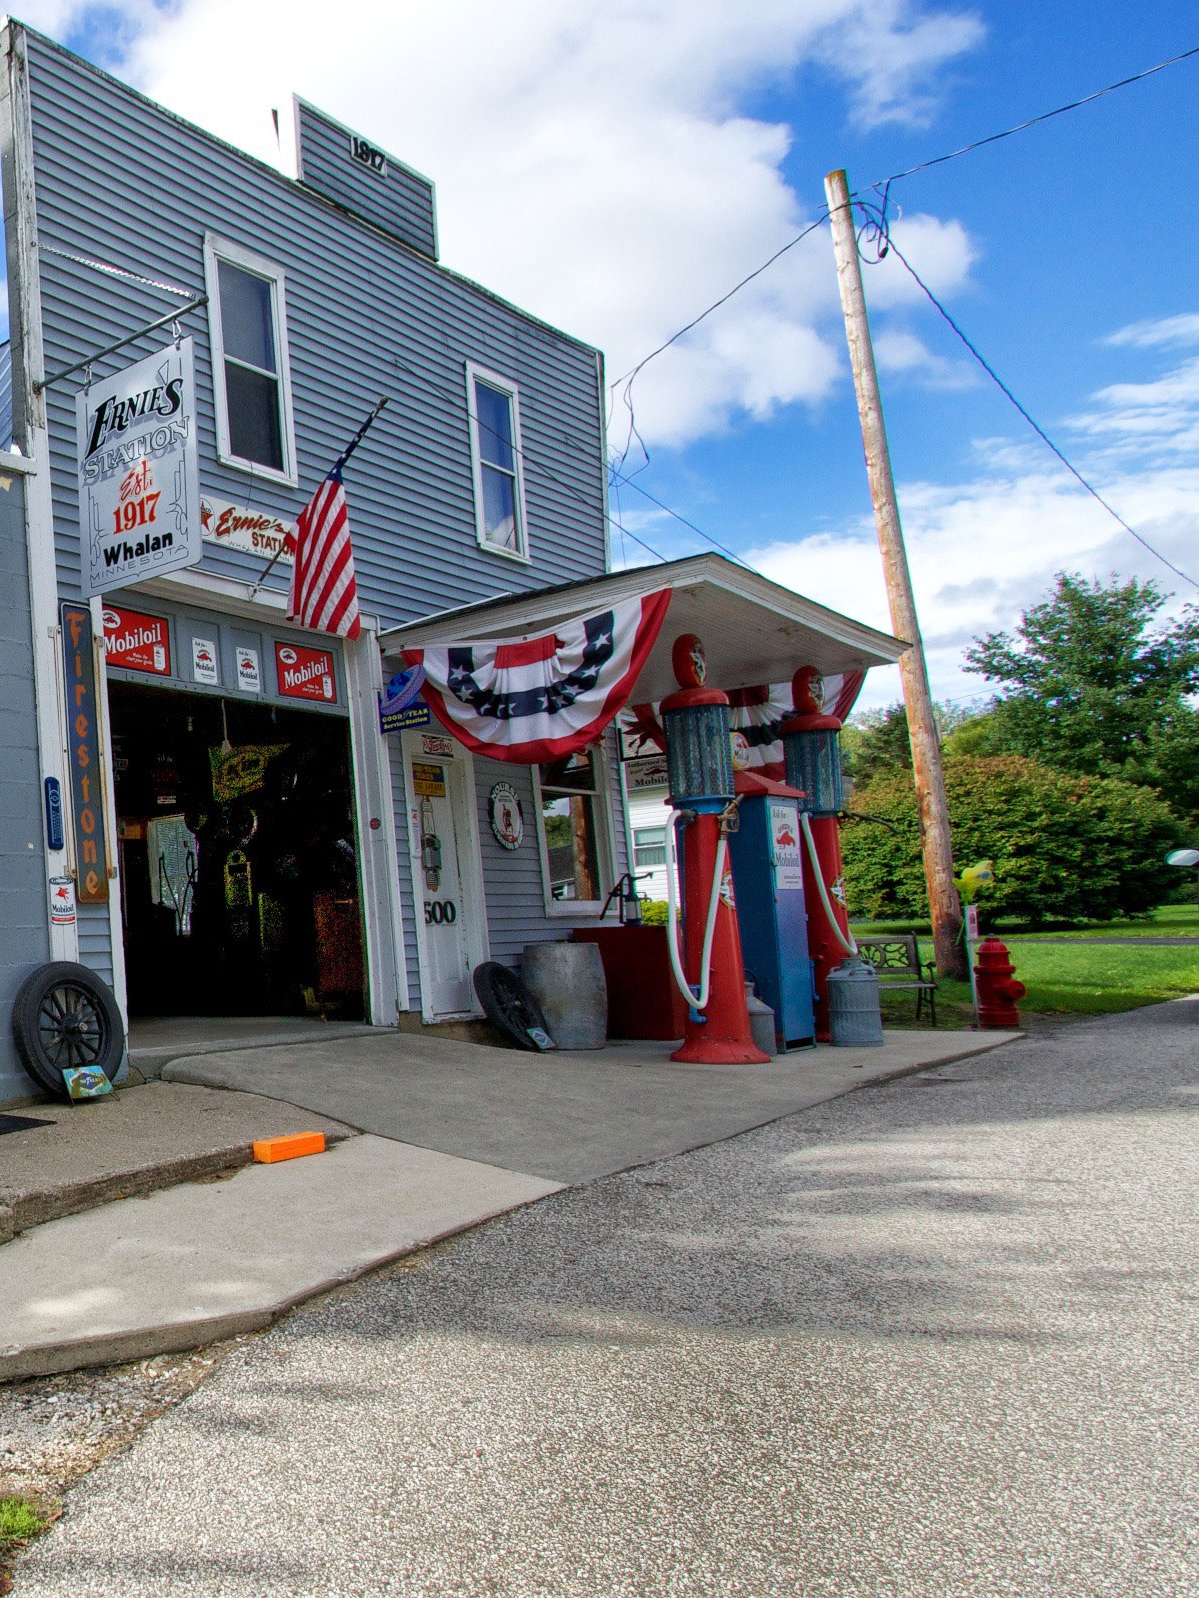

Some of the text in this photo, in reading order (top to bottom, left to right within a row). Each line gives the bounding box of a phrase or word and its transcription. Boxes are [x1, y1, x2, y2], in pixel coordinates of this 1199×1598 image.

[84, 416, 190, 482] STATION
[113, 491, 161, 535] 1917
[216, 507, 287, 537] Ernie's
[104, 532, 173, 567] Whalan
[251, 531, 296, 557] STATIO
[90, 544, 187, 582] MINNESOTA
[103, 623, 162, 656] Mobiloil
[195, 661, 215, 673] Mobiloil
[283, 656, 329, 689] Mobiloil
[383, 717, 428, 730] Service Station
[66, 612, 100, 894] Firestone
[626, 758, 660, 769] Authorized
[775, 852, 799, 867] Mobiloil
[52, 903, 74, 913] Mobiloil
[423, 900, 457, 924] 500
